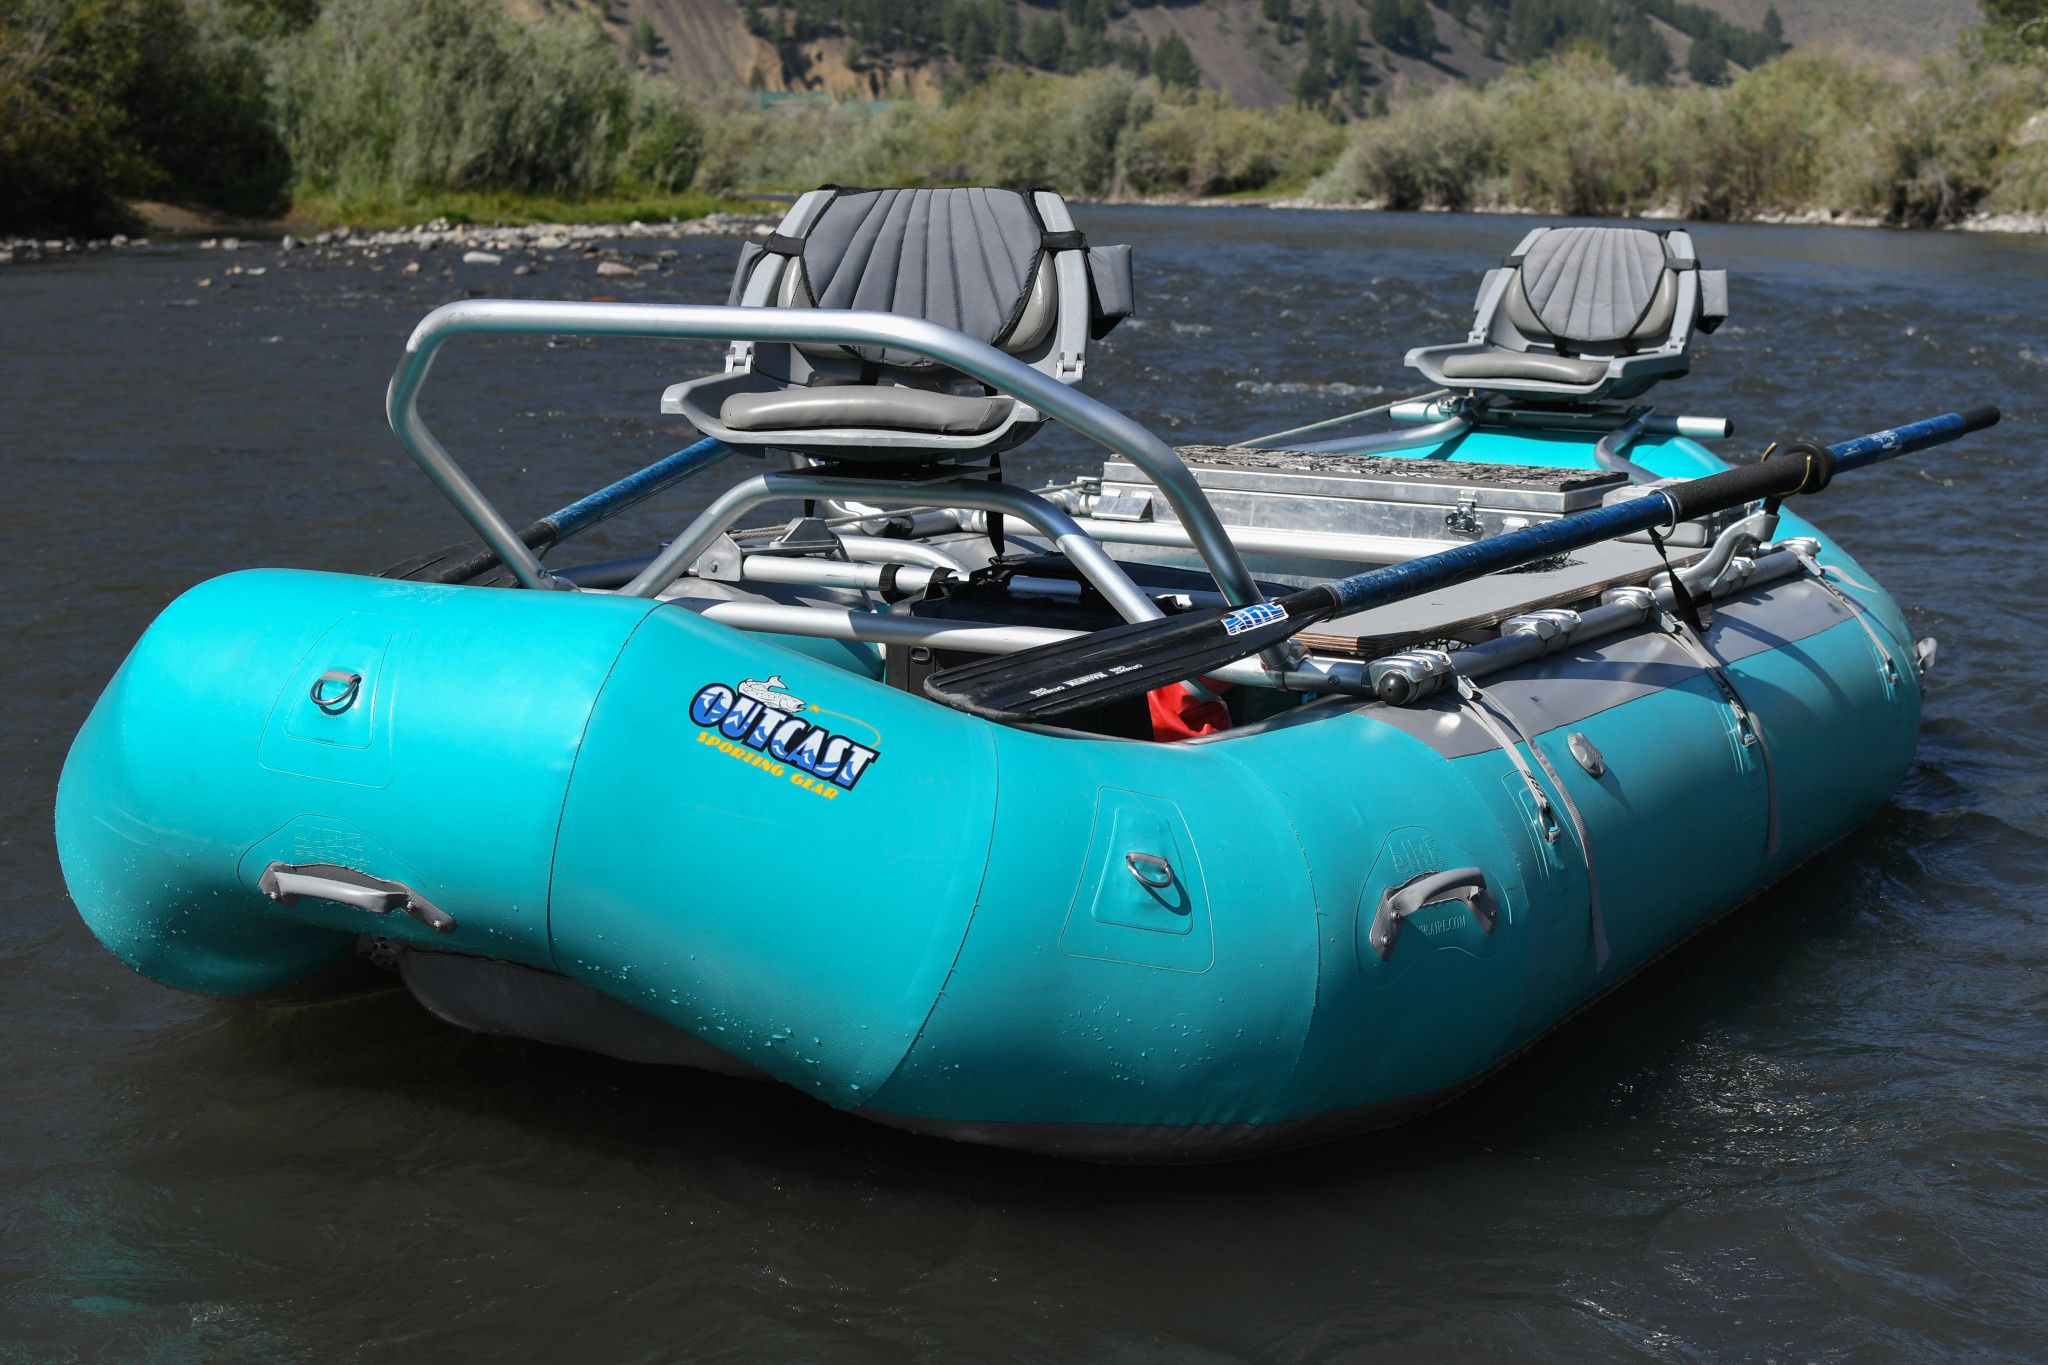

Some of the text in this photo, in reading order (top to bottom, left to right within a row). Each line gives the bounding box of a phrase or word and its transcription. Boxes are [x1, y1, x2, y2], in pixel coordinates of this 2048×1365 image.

[689, 682, 881, 791] OUTCAST
[696, 731, 839, 800] SPORTING GEAR
